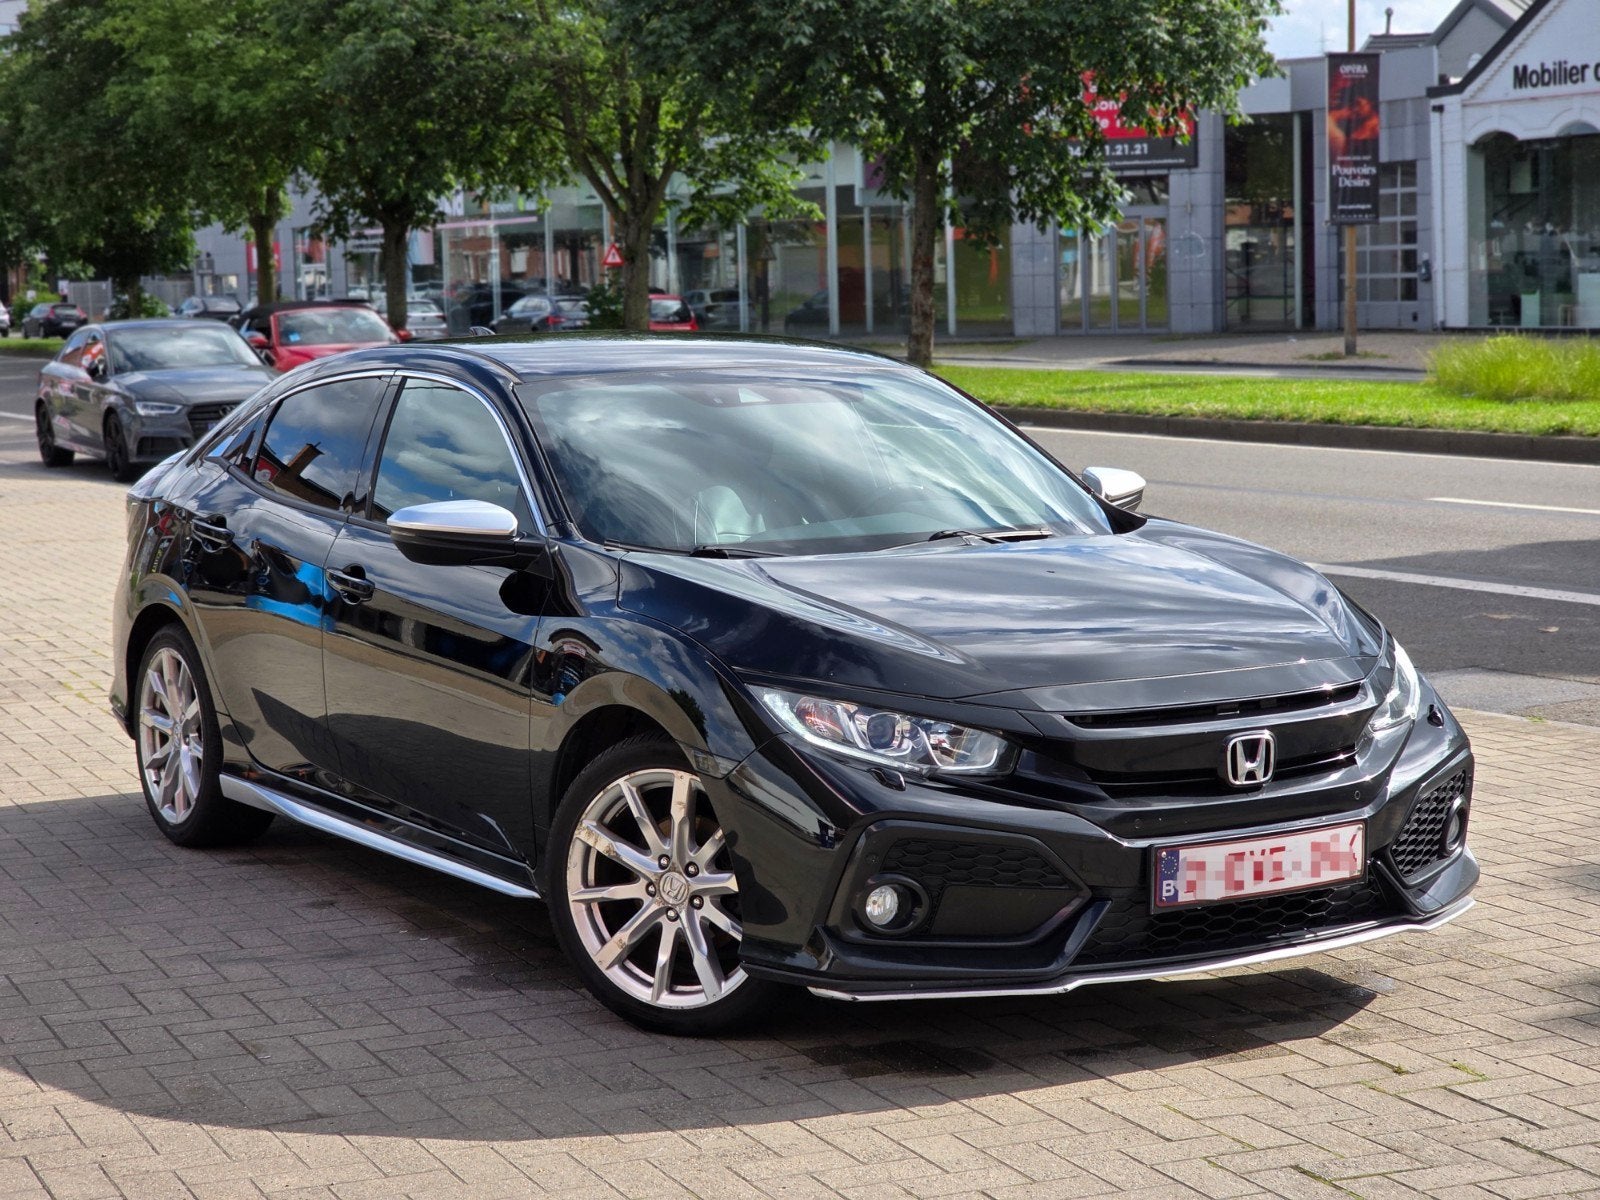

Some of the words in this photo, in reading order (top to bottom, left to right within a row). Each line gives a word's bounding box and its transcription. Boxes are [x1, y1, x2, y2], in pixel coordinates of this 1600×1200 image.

[1513, 61, 1590, 90] Mobilier
[1332, 164, 1377, 176] Pouvoirs
[1338, 176, 1371, 187] Désirs
